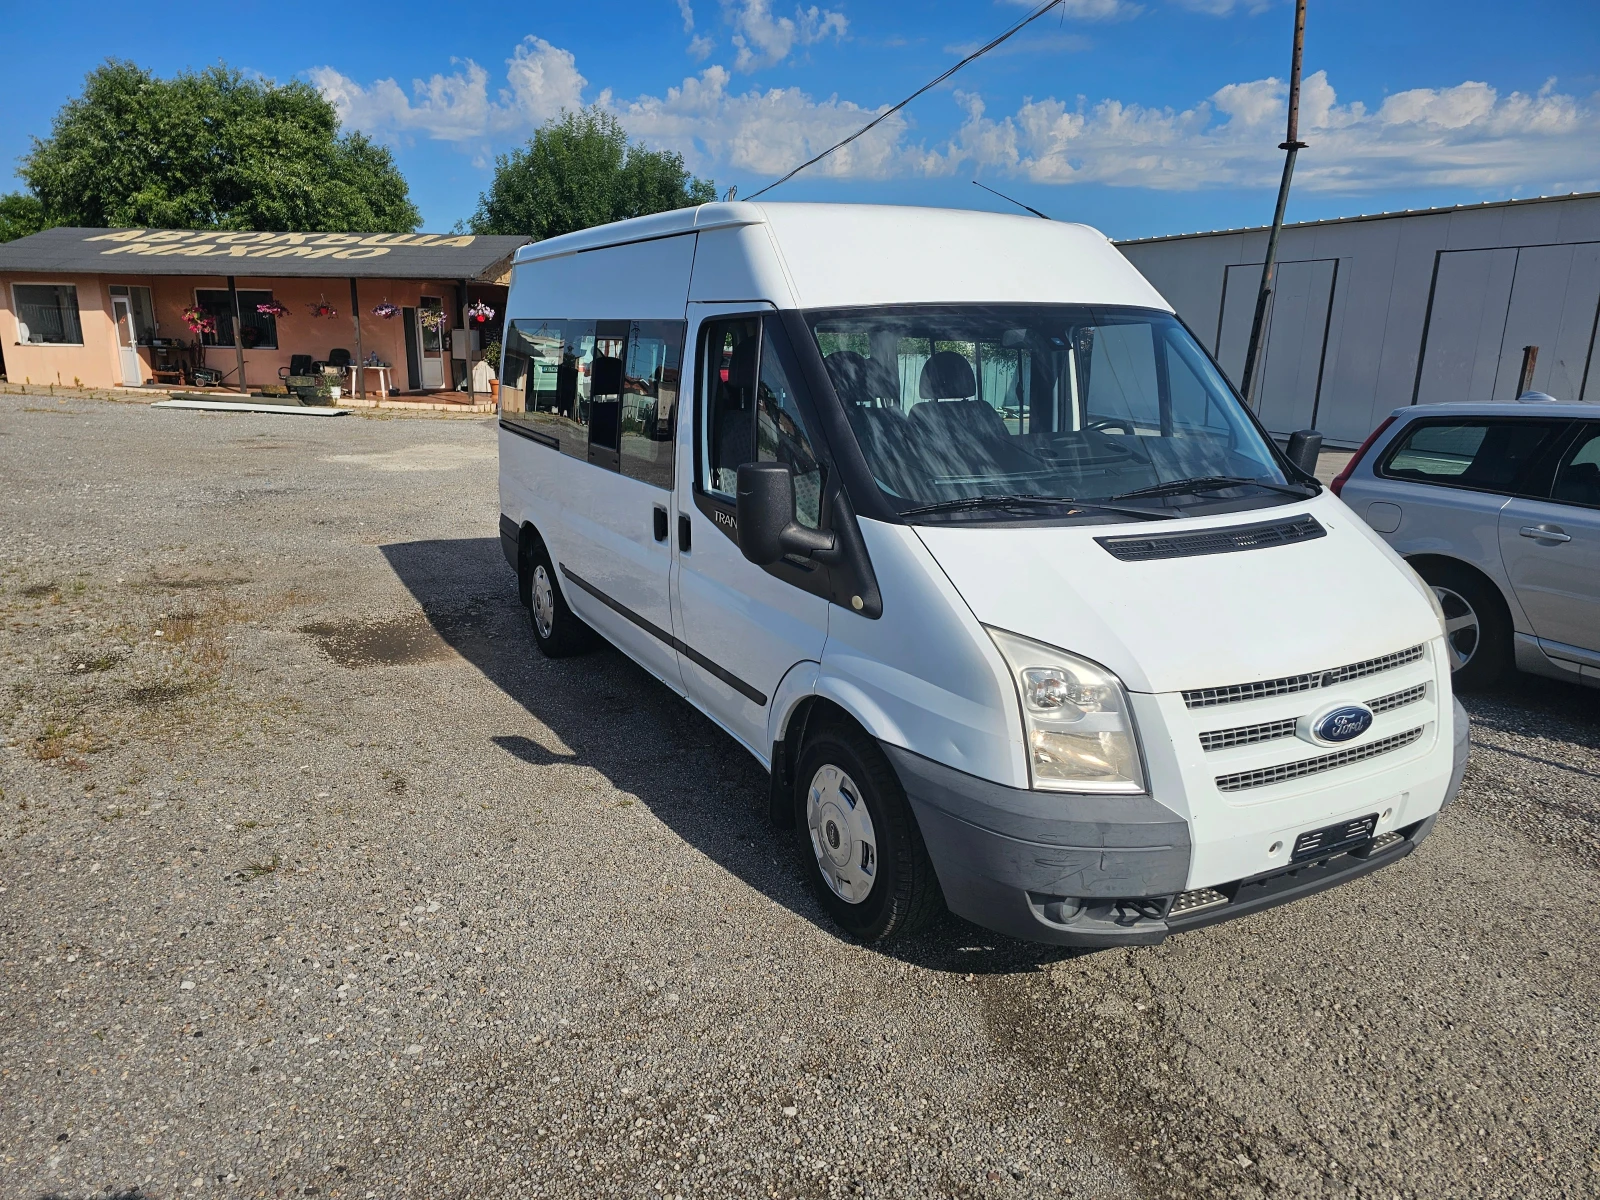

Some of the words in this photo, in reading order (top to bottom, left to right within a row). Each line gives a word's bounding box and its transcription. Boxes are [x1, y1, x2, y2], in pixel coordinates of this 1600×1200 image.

[100, 243, 391, 259] MAXIMO
[714, 510, 738, 530] TRAN
[1332, 714, 1364, 736] Ford
